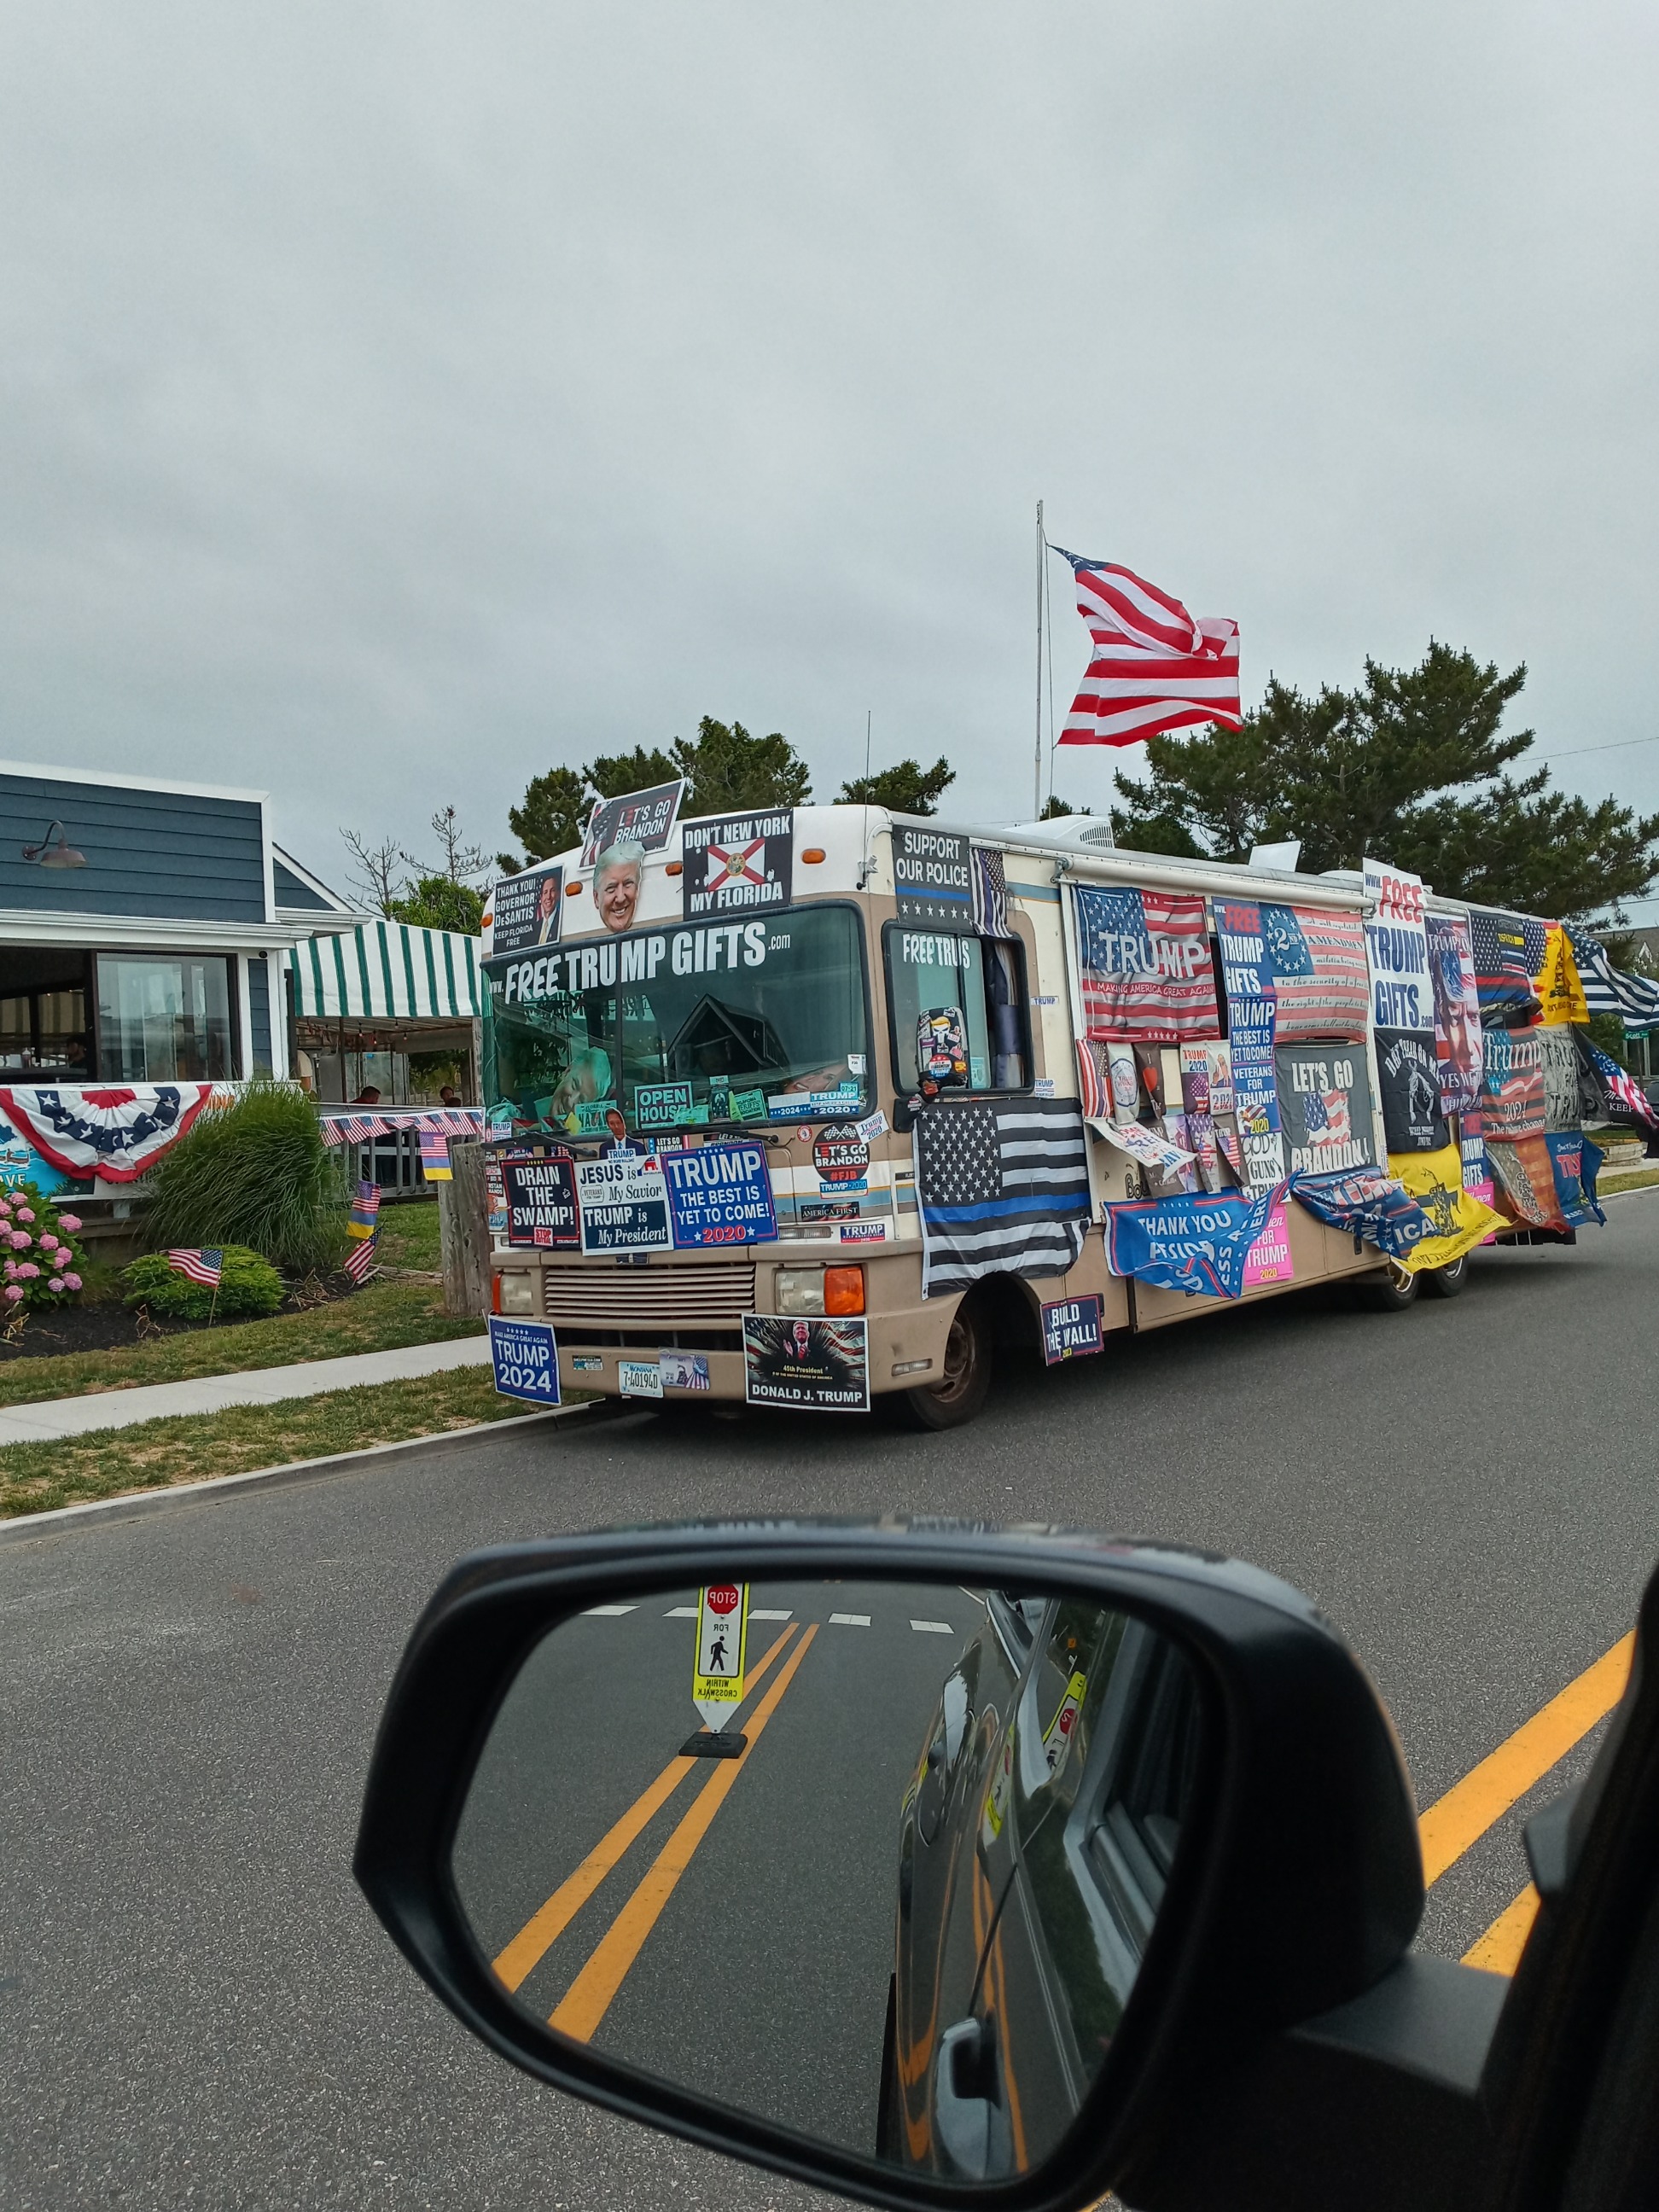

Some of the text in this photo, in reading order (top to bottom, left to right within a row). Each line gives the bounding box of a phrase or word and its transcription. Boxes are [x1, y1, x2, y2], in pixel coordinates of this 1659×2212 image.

[654, 799, 671, 816] GO
[614, 818, 667, 845] BRANDON
[685, 815, 790, 850] DON'T NEW YORK
[904, 831, 961, 860] SUPPORT
[896, 857, 969, 888] OUR POLICE
[497, 883, 520, 899] THANK
[690, 881, 783, 913] MY FLORIDA
[1379, 875, 1423, 924] FREE
[496, 893, 535, 913] GOVERNOR
[1225, 905, 1261, 934] FREE
[495, 924, 533, 940] KEEP FLORIDA
[506, 937, 521, 947] FREE
[903, 934, 935, 965] FREE
[1221, 934, 1264, 963] TRUMP
[1307, 935, 1364, 950] AMENDMEN
[1367, 924, 1426, 975] TRUMP
[1427, 934, 1458, 952] TRUMP
[505, 954, 562, 1004] FREE
[564, 935, 666, 992] TRUMP
[672, 921, 766, 976] GIFTS
[1098, 931, 1206, 980] TRUMP
[1097, 982, 1128, 993] MAKING
[1130, 984, 1161, 995] AMERICA
[1163, 987, 1187, 997] GREAT
[1226, 967, 1262, 994] GIFTS
[1375, 980, 1420, 1029] GIFTS
[1229, 1002, 1275, 1027] TRUMP
[1232, 1029, 1270, 1046] THE BEST IS
[1183, 1050, 1208, 1060] TRUMP
[1231, 1045, 1274, 1062] YET TO COME!
[1482, 1032, 1542, 1072] Trump
[1233, 1066, 1273, 1080] VETERANS
[1291, 1059, 1353, 1092] LET'S GO
[1440, 1073, 1460, 1089] YES
[1247, 1078, 1263, 1091] FOR
[640, 1088, 687, 1107] OPEN
[811, 1092, 856, 1101] TRUMP
[1236, 1089, 1277, 1107] TRUMP
[781, 1106, 851, 1115] 2024 2020
[492, 1122, 510, 1131] TRUMP
[859, 1115, 883, 1132] Trump
[866, 1126, 883, 1140] 2020
[1250, 1118, 1270, 1134] 2020
[1492, 1122, 1505, 1135] The
[657, 1136, 680, 1145] LET'S GO
[1243, 1134, 1271, 1156] GOD
[1462, 1138, 1484, 1161] TRUMP
[608, 1150, 634, 1159] TRUMP
[815, 1144, 867, 1158] LET'S GO
[1291, 1137, 1371, 1176] BRANDON!
[667, 1149, 761, 1189] TRUMP
[815, 1155, 869, 1168] BRANDON
[1249, 1159, 1277, 1179] GUNS
[515, 1166, 561, 1186] DRAIN
[580, 1164, 637, 1185] JESUS is
[830, 1170, 858, 1181] #FJB
[1463, 1163, 1483, 1189] GIFTS
[525, 1187, 555, 1206] THE
[608, 1183, 662, 1203] My Savior
[680, 1185, 760, 1208] THE BEST IS
[821, 1183, 847, 1191] TRUMP
[513, 1206, 574, 1226] SWAMP!
[585, 1206, 648, 1227] TRUMP is
[677, 1202, 771, 1226] YET TO COME!
[802, 1208, 835, 1218] AMERICA
[844, 1225, 883, 1236] TRUMP
[1138, 1209, 1231, 1237] THANK YOU
[535, 1229, 551, 1237] STOP
[598, 1226, 667, 1247] My President
[702, 1225, 747, 1243] 2020
[1247, 1243, 1289, 1268] TRUMP
[1260, 1267, 1278, 1279] 2020
[504, 1332, 519, 1341] AMERICA
[519, 1335, 533, 1343] GREAT
[495, 1338, 550, 1367] TRUMP
[498, 1363, 552, 1393] 2024
[629, 1365, 653, 1374] MONTANA
[752, 1384, 863, 1403] DONALD J. TRUMP
